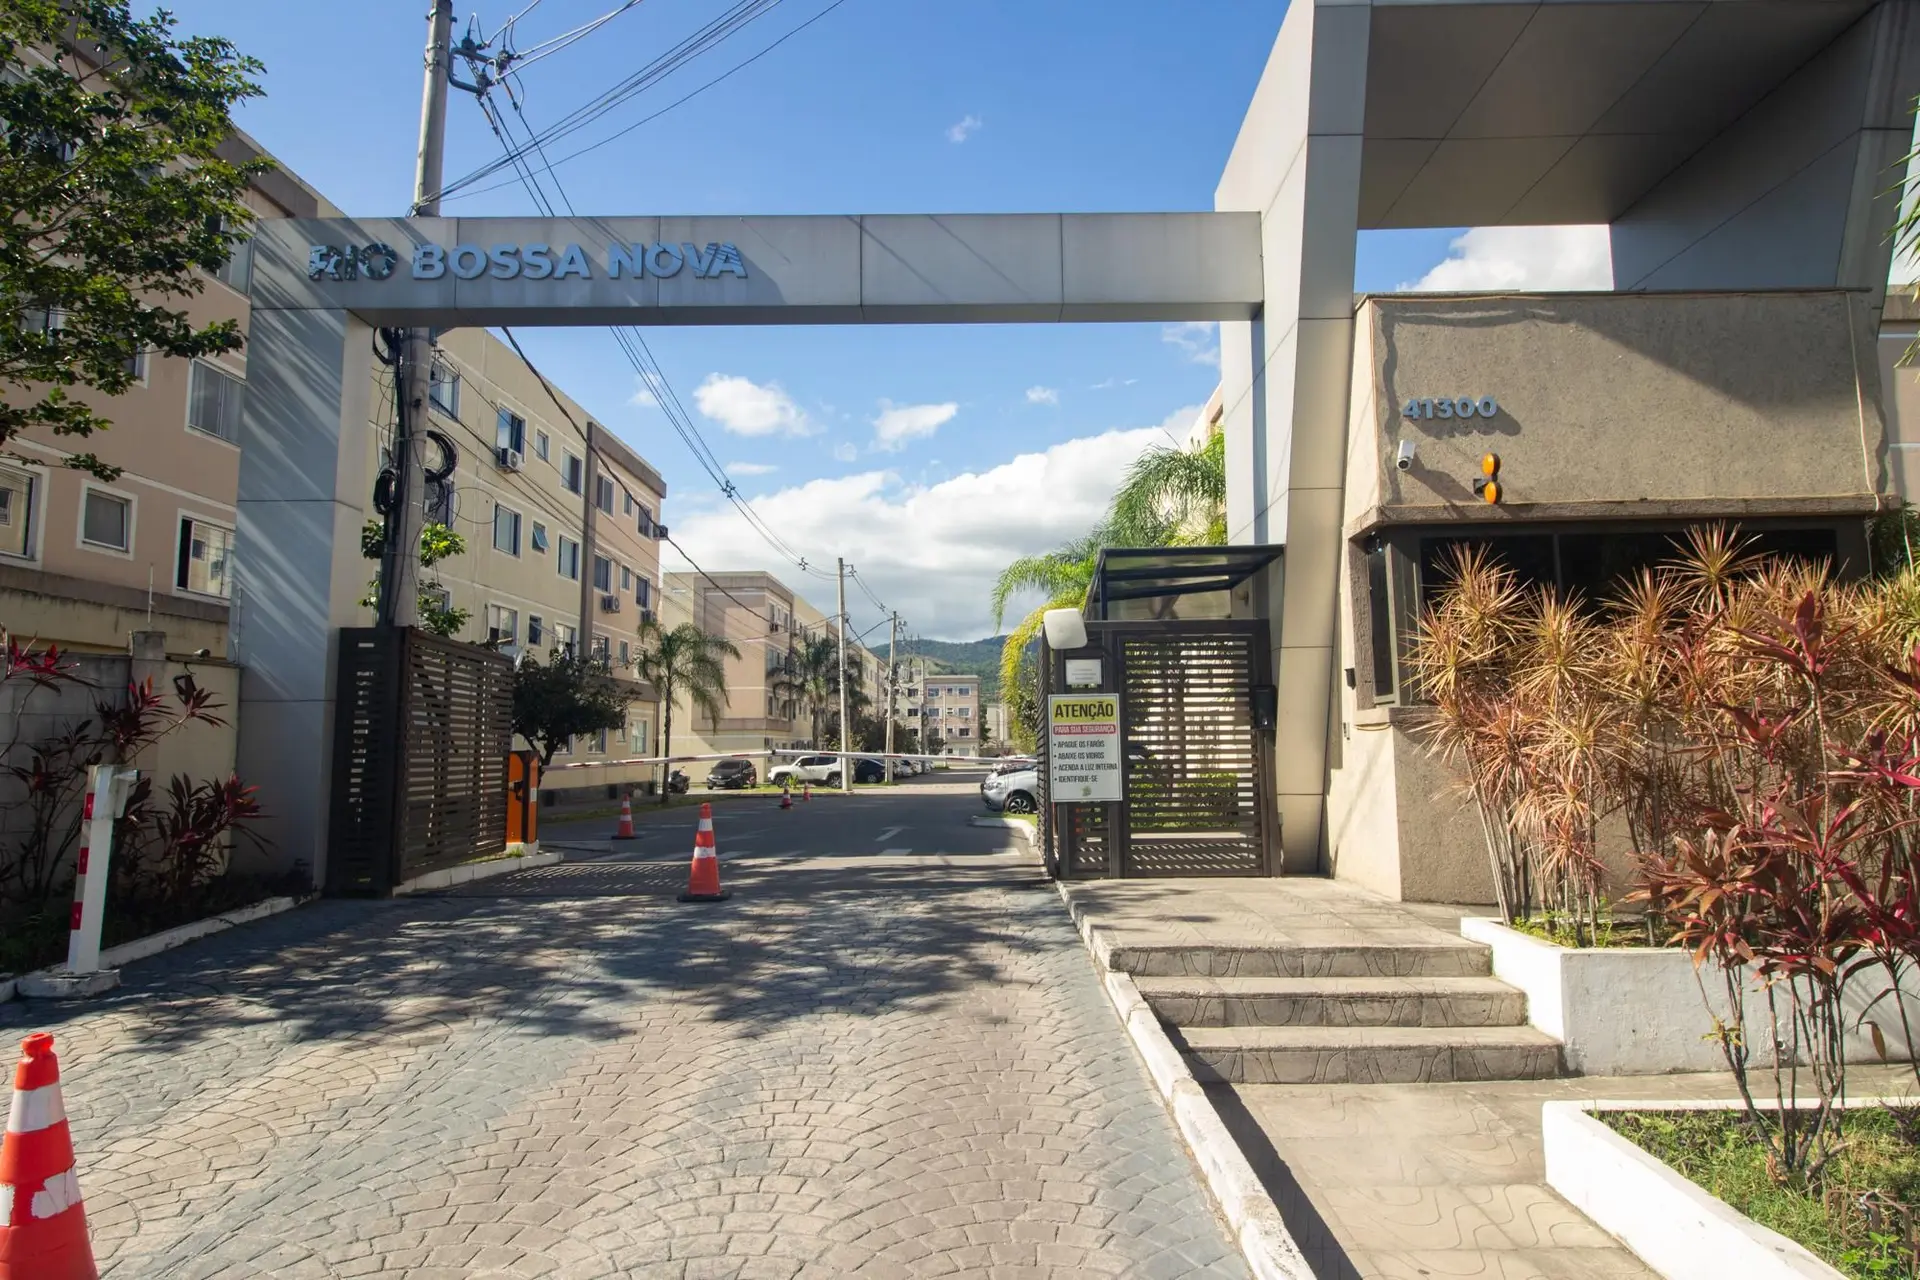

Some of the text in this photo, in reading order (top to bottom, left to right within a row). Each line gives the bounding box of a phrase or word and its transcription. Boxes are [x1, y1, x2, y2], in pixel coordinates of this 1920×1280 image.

[308, 242, 748, 281] RIO BOSSA NOVA
[1402, 395, 1498, 419] 41300
[1054, 702, 1114, 720] ATENÇÃO
[1078, 752, 1085, 760] OS
[1058, 775, 1098, 783] IDENTIFIQUE-SE
